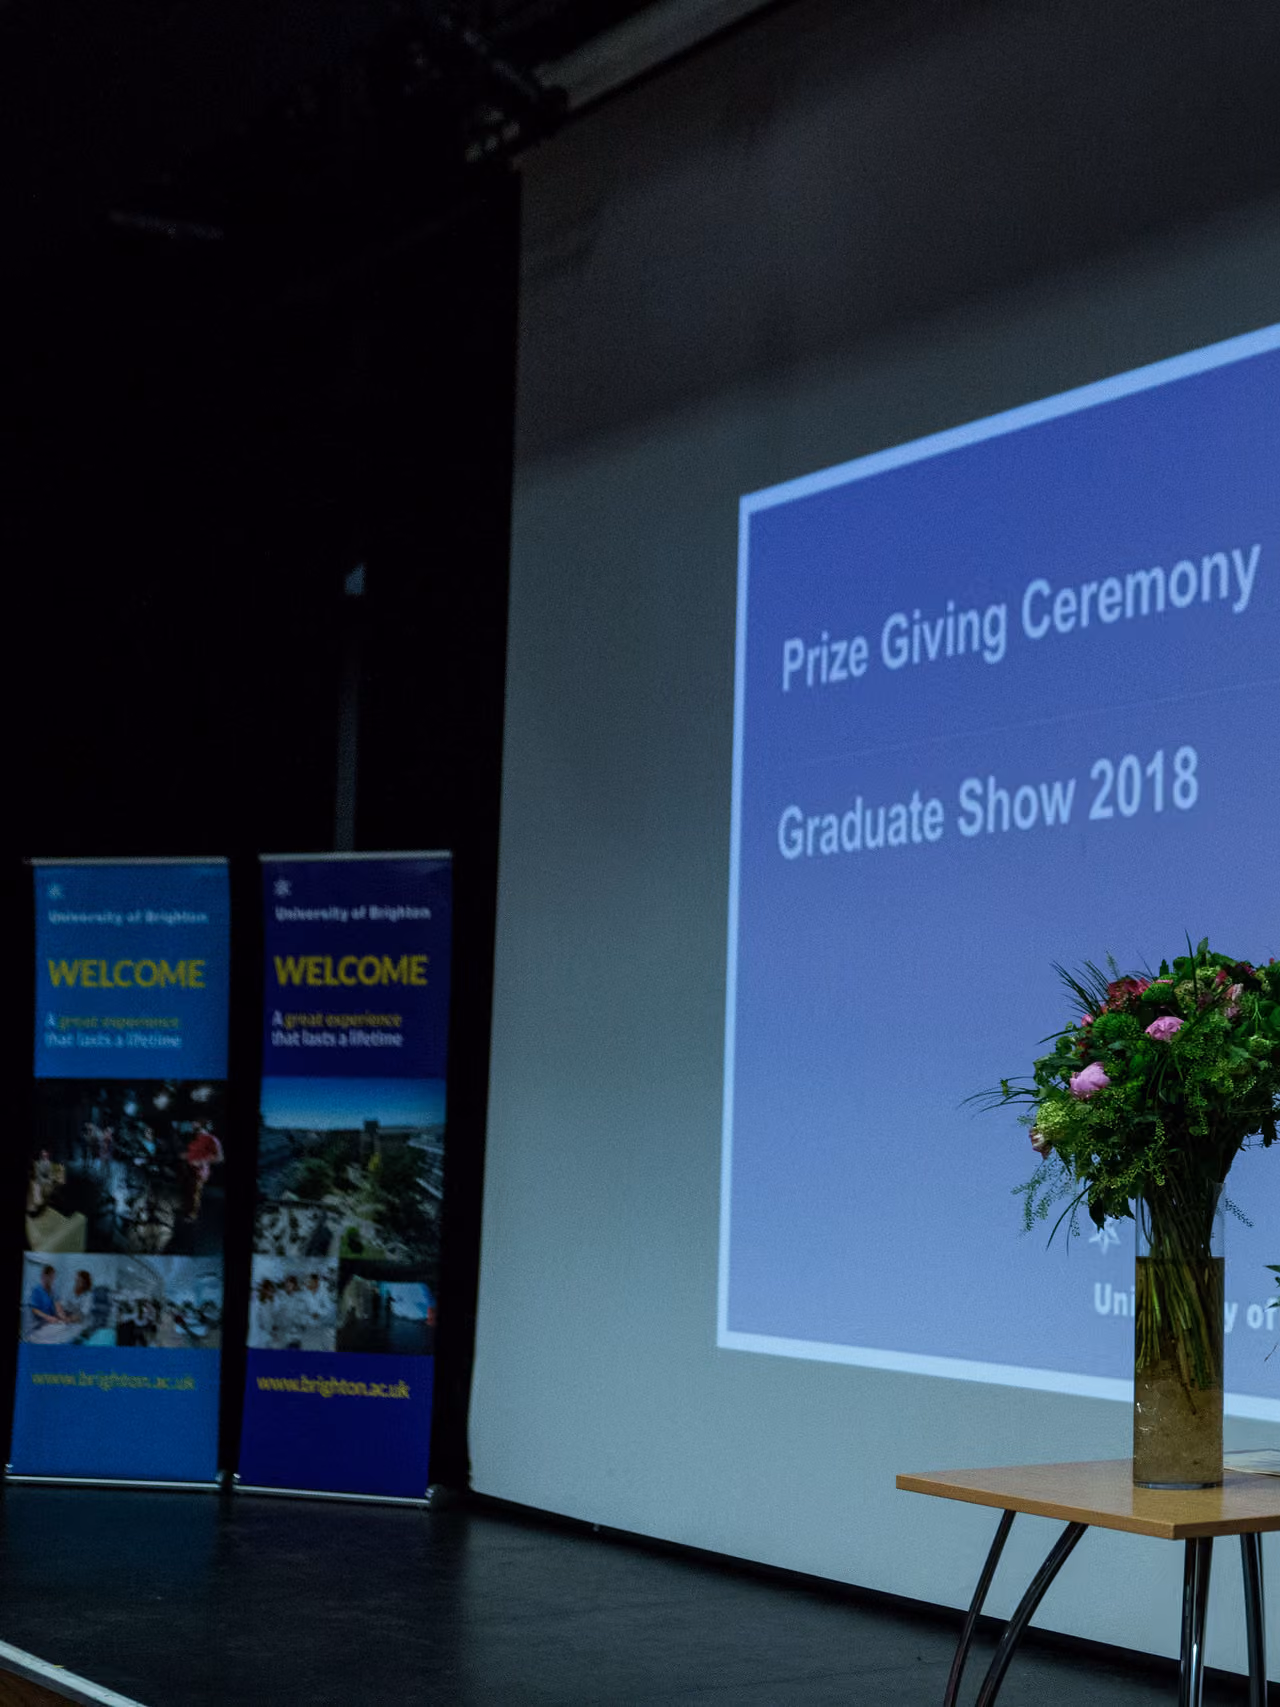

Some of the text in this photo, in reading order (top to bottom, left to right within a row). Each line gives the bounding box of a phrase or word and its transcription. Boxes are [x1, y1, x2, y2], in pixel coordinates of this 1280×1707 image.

[782, 543, 1262, 692] Prize Giving Ceremony
[778, 745, 1199, 860] Graduate Show 2018
[274, 904, 432, 923] University of Brighton
[48, 959, 206, 989] WELCOME
[273, 953, 429, 987] WELCOME
[271, 1009, 284, 1027] A
[326, 1012, 402, 1030] experience
[271, 1028, 300, 1047] that
[302, 1028, 337, 1047] lasts
[349, 1028, 404, 1047] lifetime
[1246, 1297, 1279, 1331] of
[256, 1373, 411, 1399] www.brighton.ac.uk
